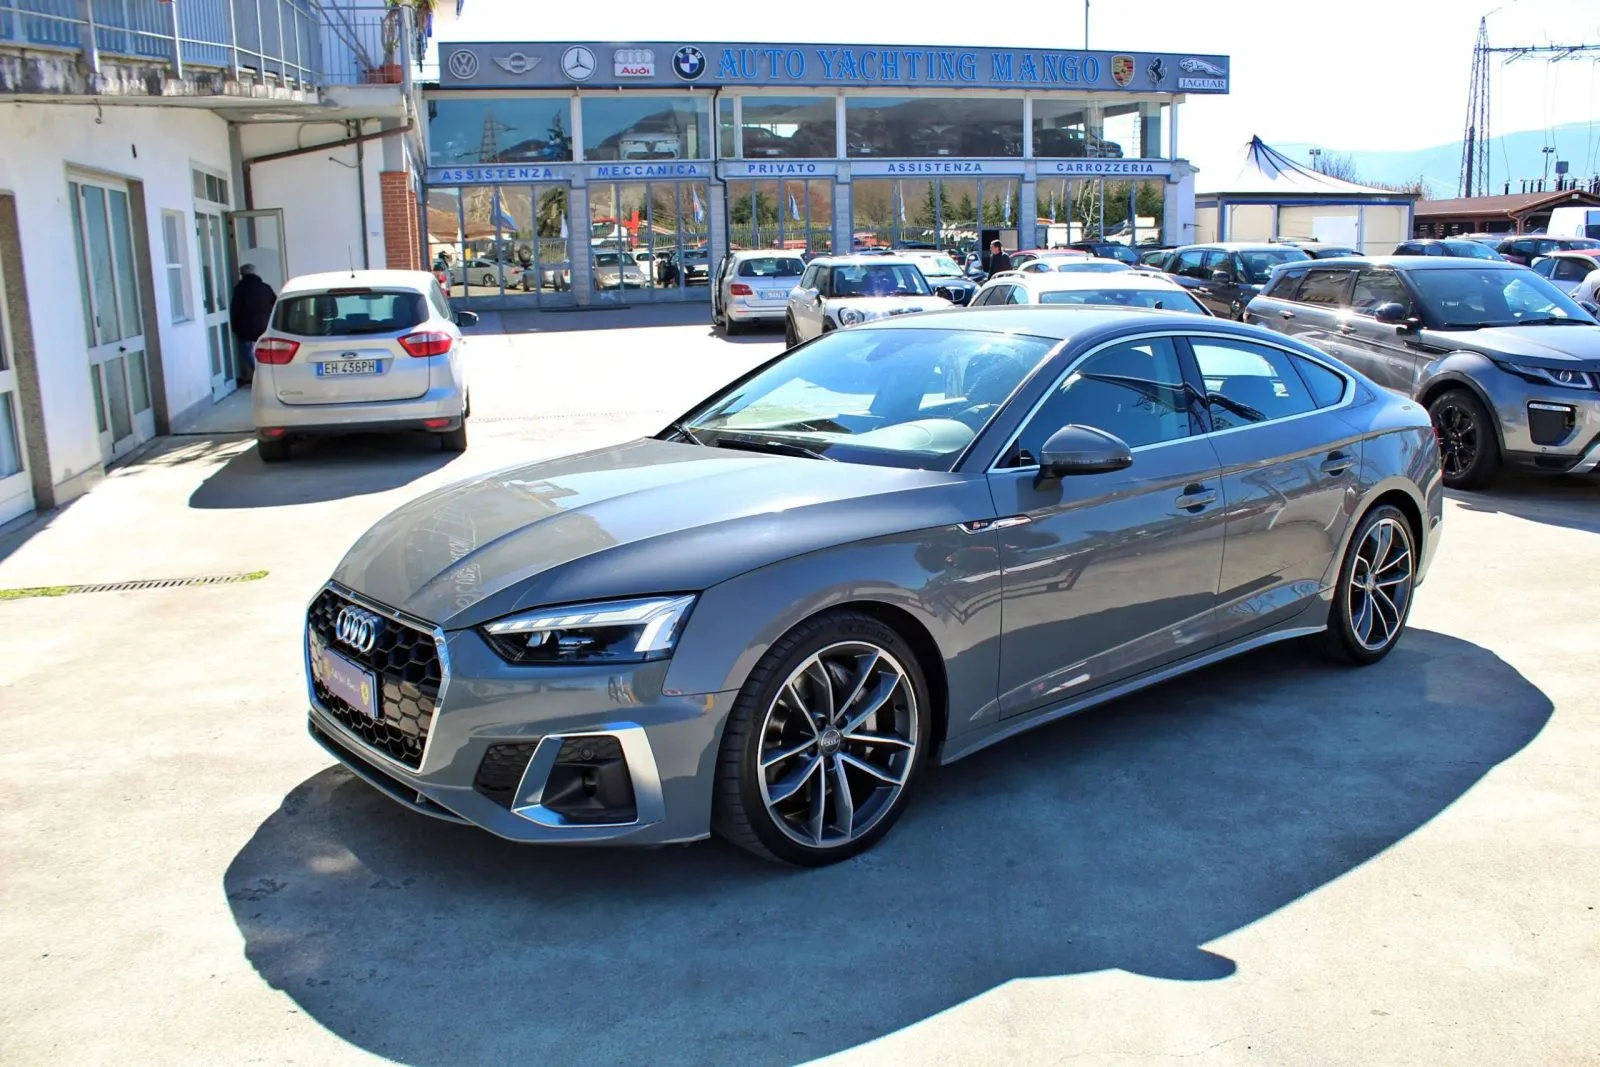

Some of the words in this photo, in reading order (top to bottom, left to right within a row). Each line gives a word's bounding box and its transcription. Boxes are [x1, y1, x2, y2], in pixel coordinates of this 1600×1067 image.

[621, 66, 650, 75] Audi
[717, 47, 804, 80] AUTO
[818, 49, 977, 82] YACHTING
[991, 52, 1101, 84] MANGO
[1181, 77, 1225, 90] JAGUAR
[597, 164, 698, 177] MECCANICA
[748, 163, 816, 174] PRIVATO
[887, 162, 983, 173] ASSISTENZA
[1056, 162, 1154, 173] CARROZZERIA
[442, 168, 553, 181] ASSISTENZA
[324, 363, 338, 374] EH
[342, 361, 375, 373] 436PH
